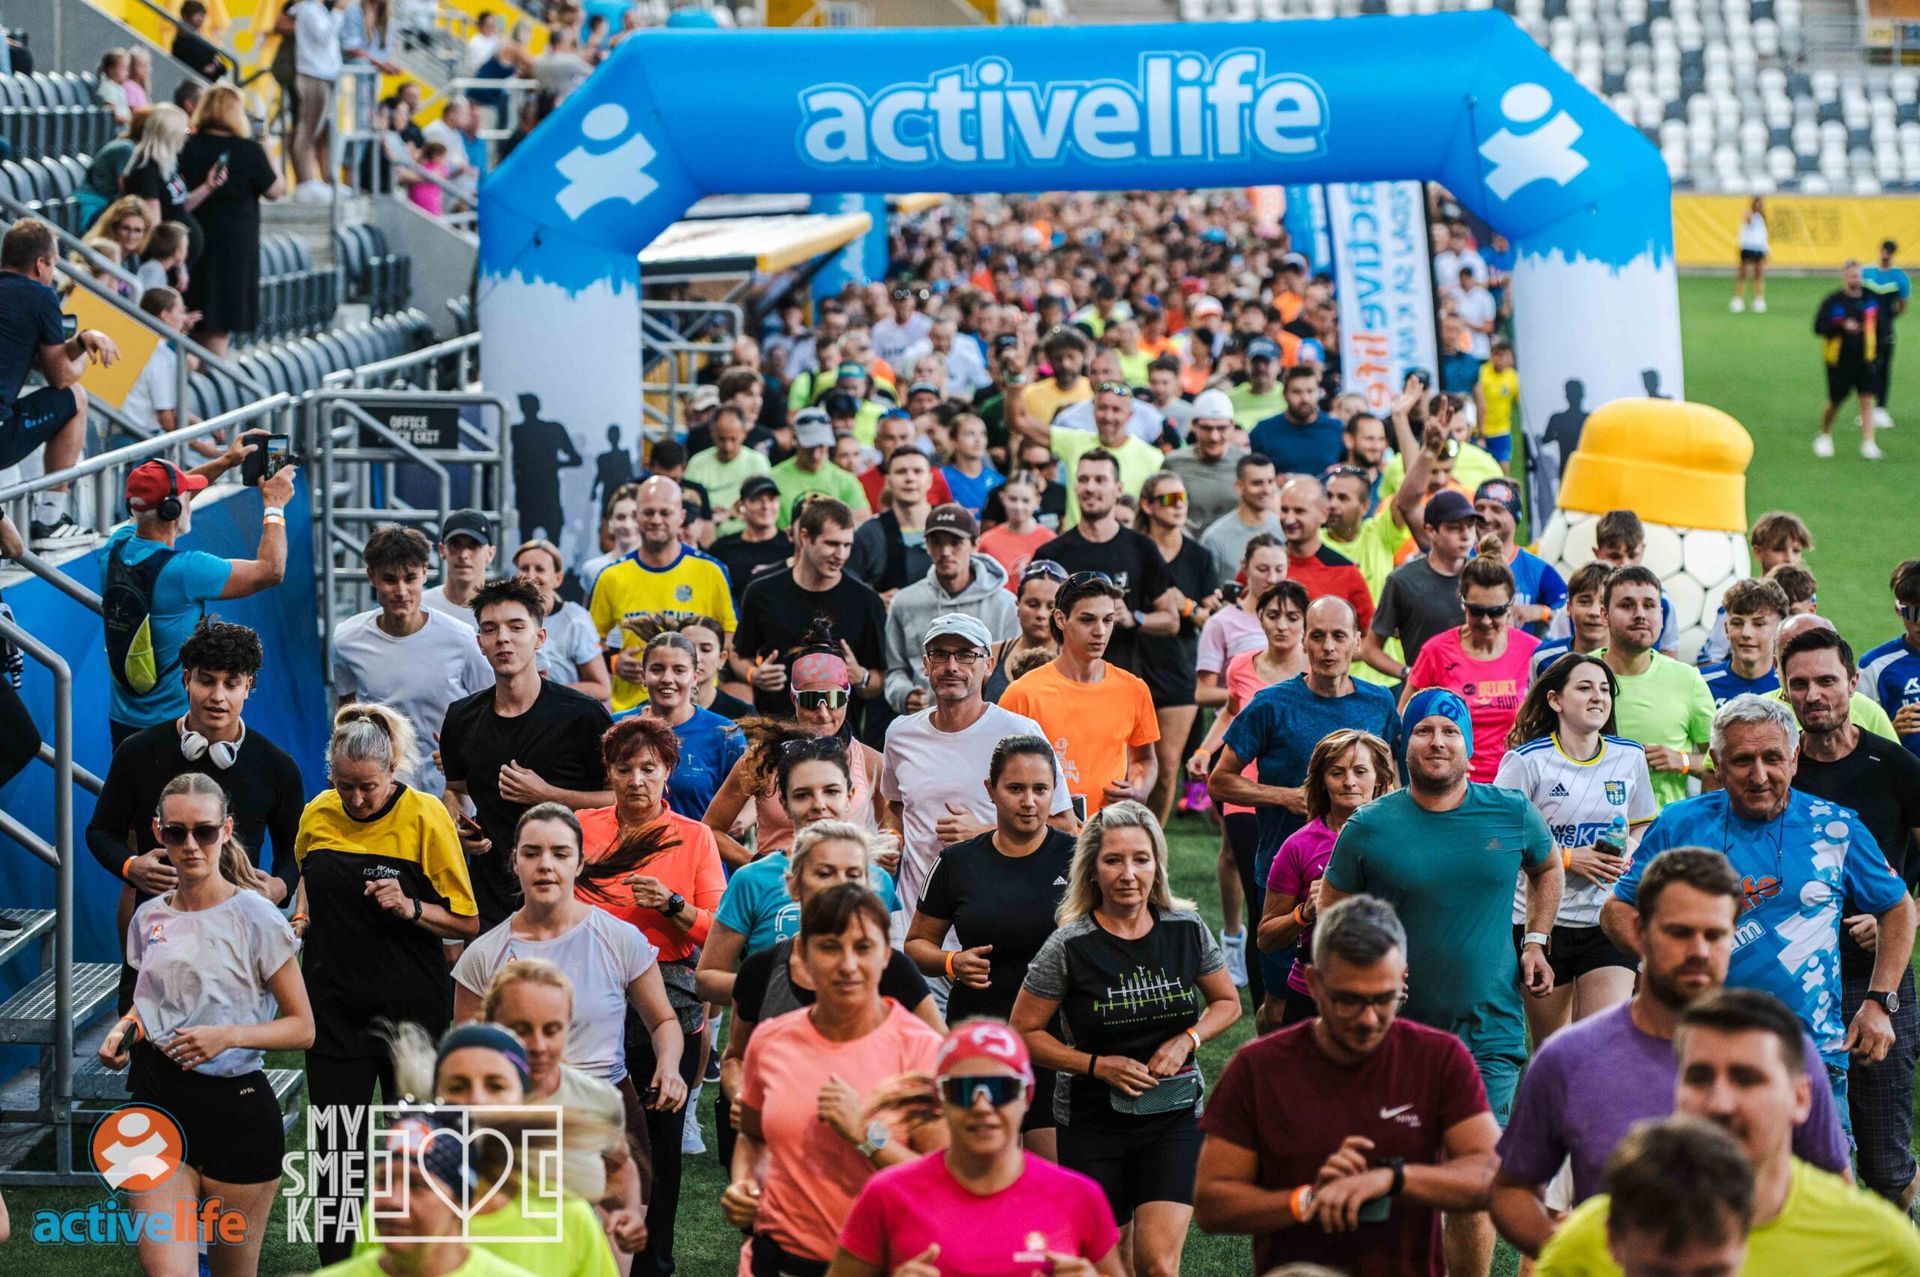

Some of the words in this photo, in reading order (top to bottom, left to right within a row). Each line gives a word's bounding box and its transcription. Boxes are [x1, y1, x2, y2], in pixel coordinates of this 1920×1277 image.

[801, 52, 1325, 164] activelife
[389, 415, 428, 429] OFFICE
[413, 429, 440, 444] EXIT
